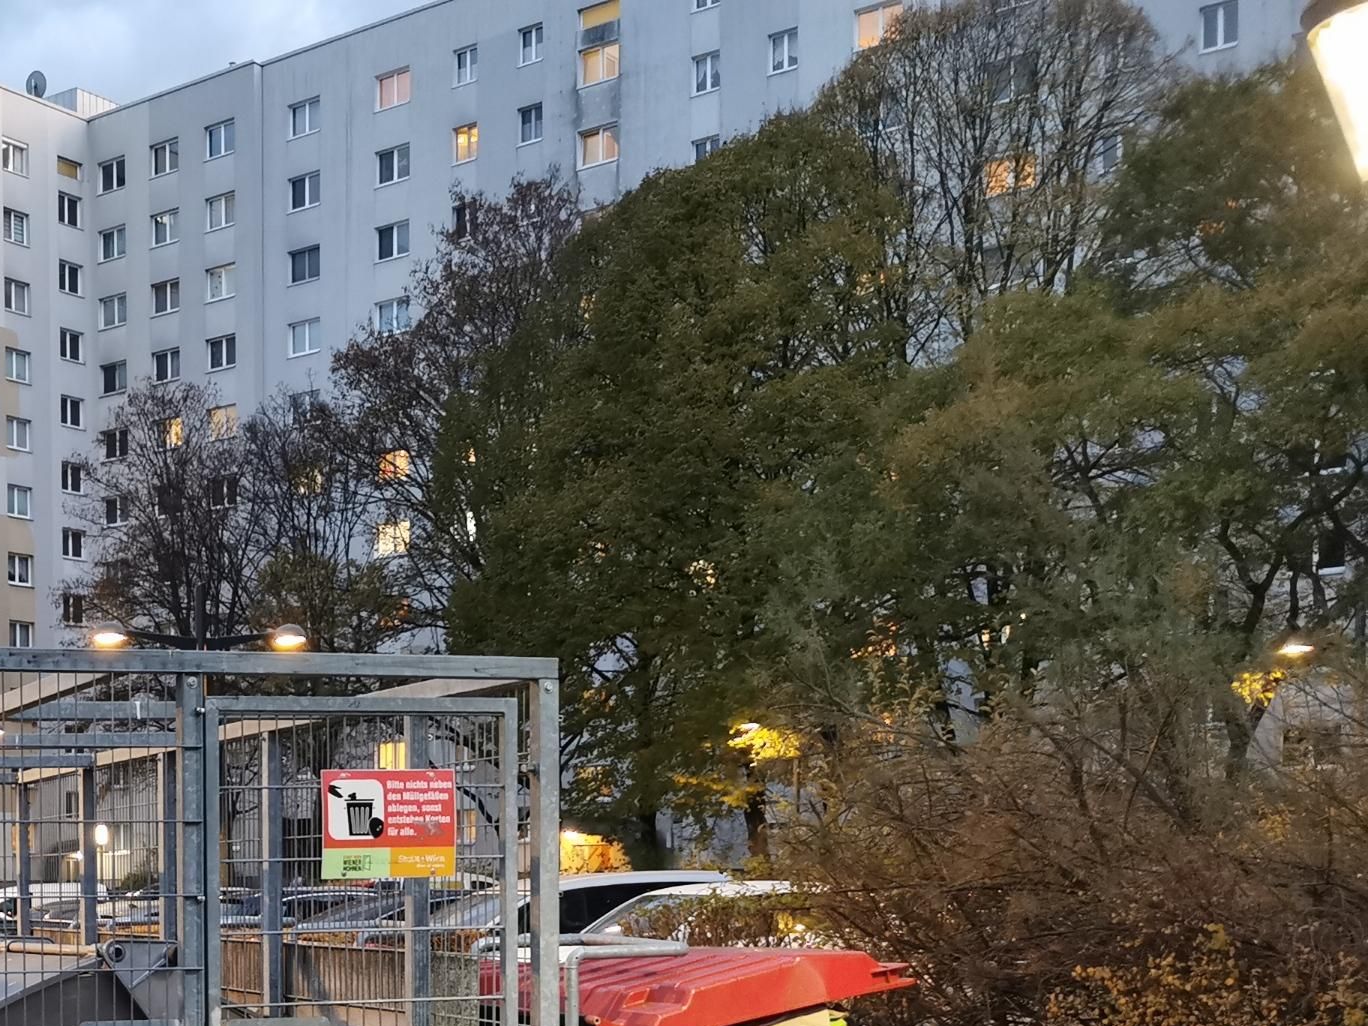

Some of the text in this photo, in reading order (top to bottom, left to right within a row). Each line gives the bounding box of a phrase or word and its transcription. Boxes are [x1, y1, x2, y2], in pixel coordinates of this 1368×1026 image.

[386, 780, 452, 789] Bitte nichts neben
[387, 791, 401, 800] den
[421, 803, 442, 812] sonst
[387, 814, 424, 824] entstehen
[387, 826, 398, 836] für
